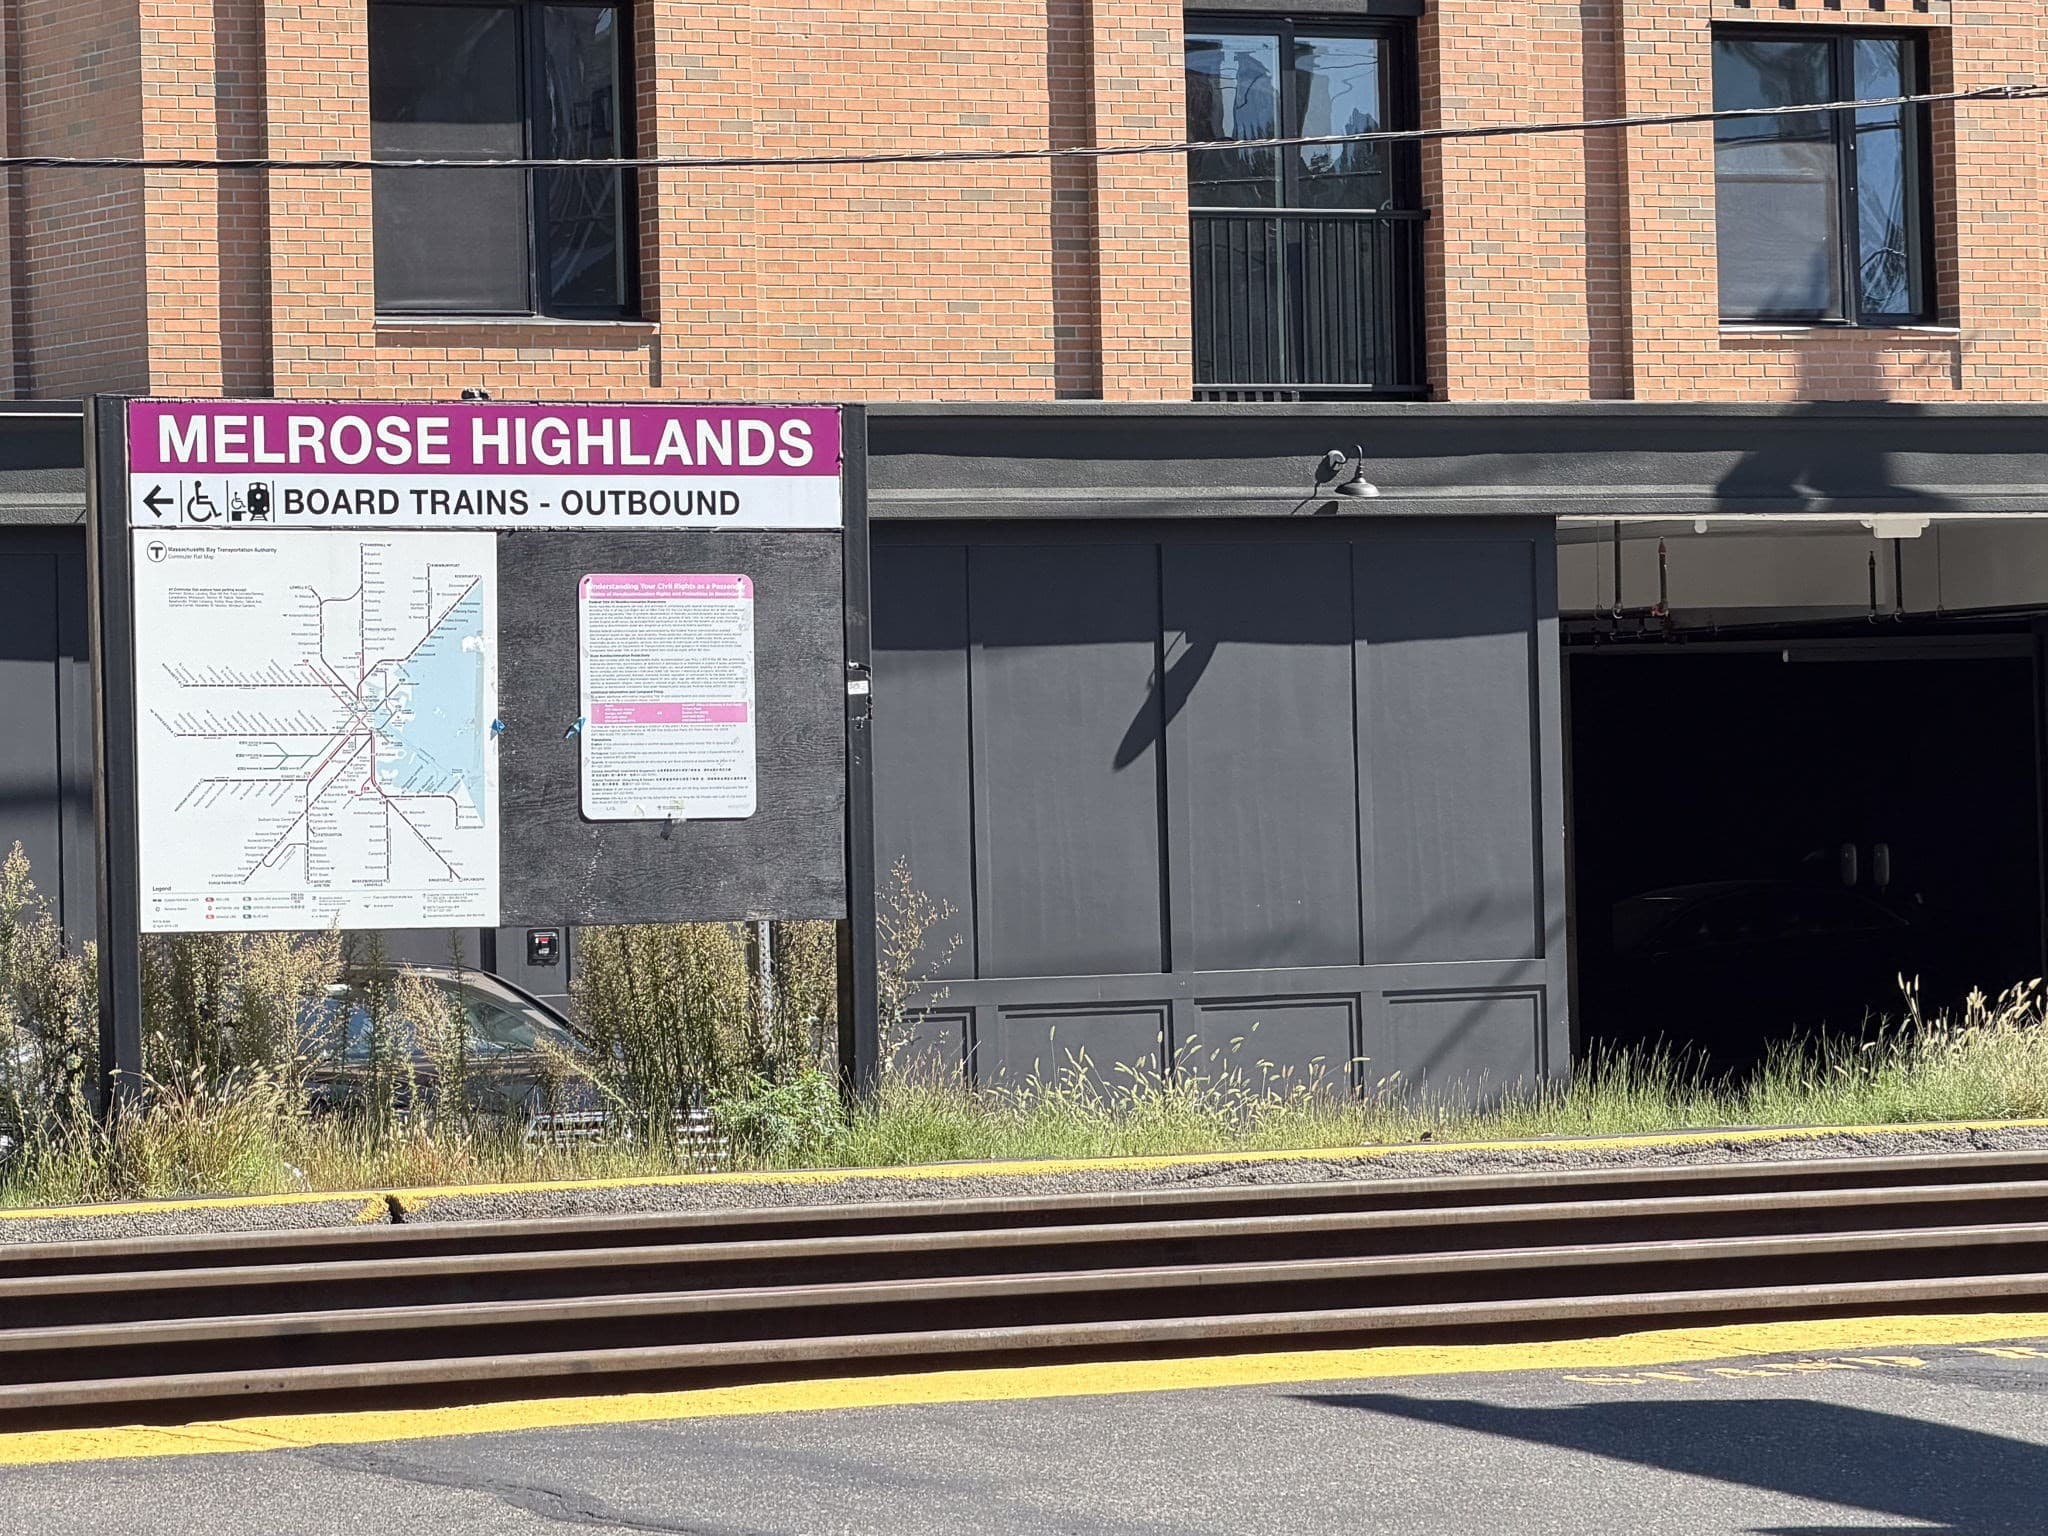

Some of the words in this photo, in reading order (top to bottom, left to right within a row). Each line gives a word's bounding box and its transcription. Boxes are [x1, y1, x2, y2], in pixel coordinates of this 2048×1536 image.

[158, 415, 450, 465] MELROSE
[471, 416, 813, 467] HIGHLANDS
[284, 489, 399, 515] BOARD
[410, 489, 528, 515] TRAINS
[561, 489, 740, 516] OUTBOUND
